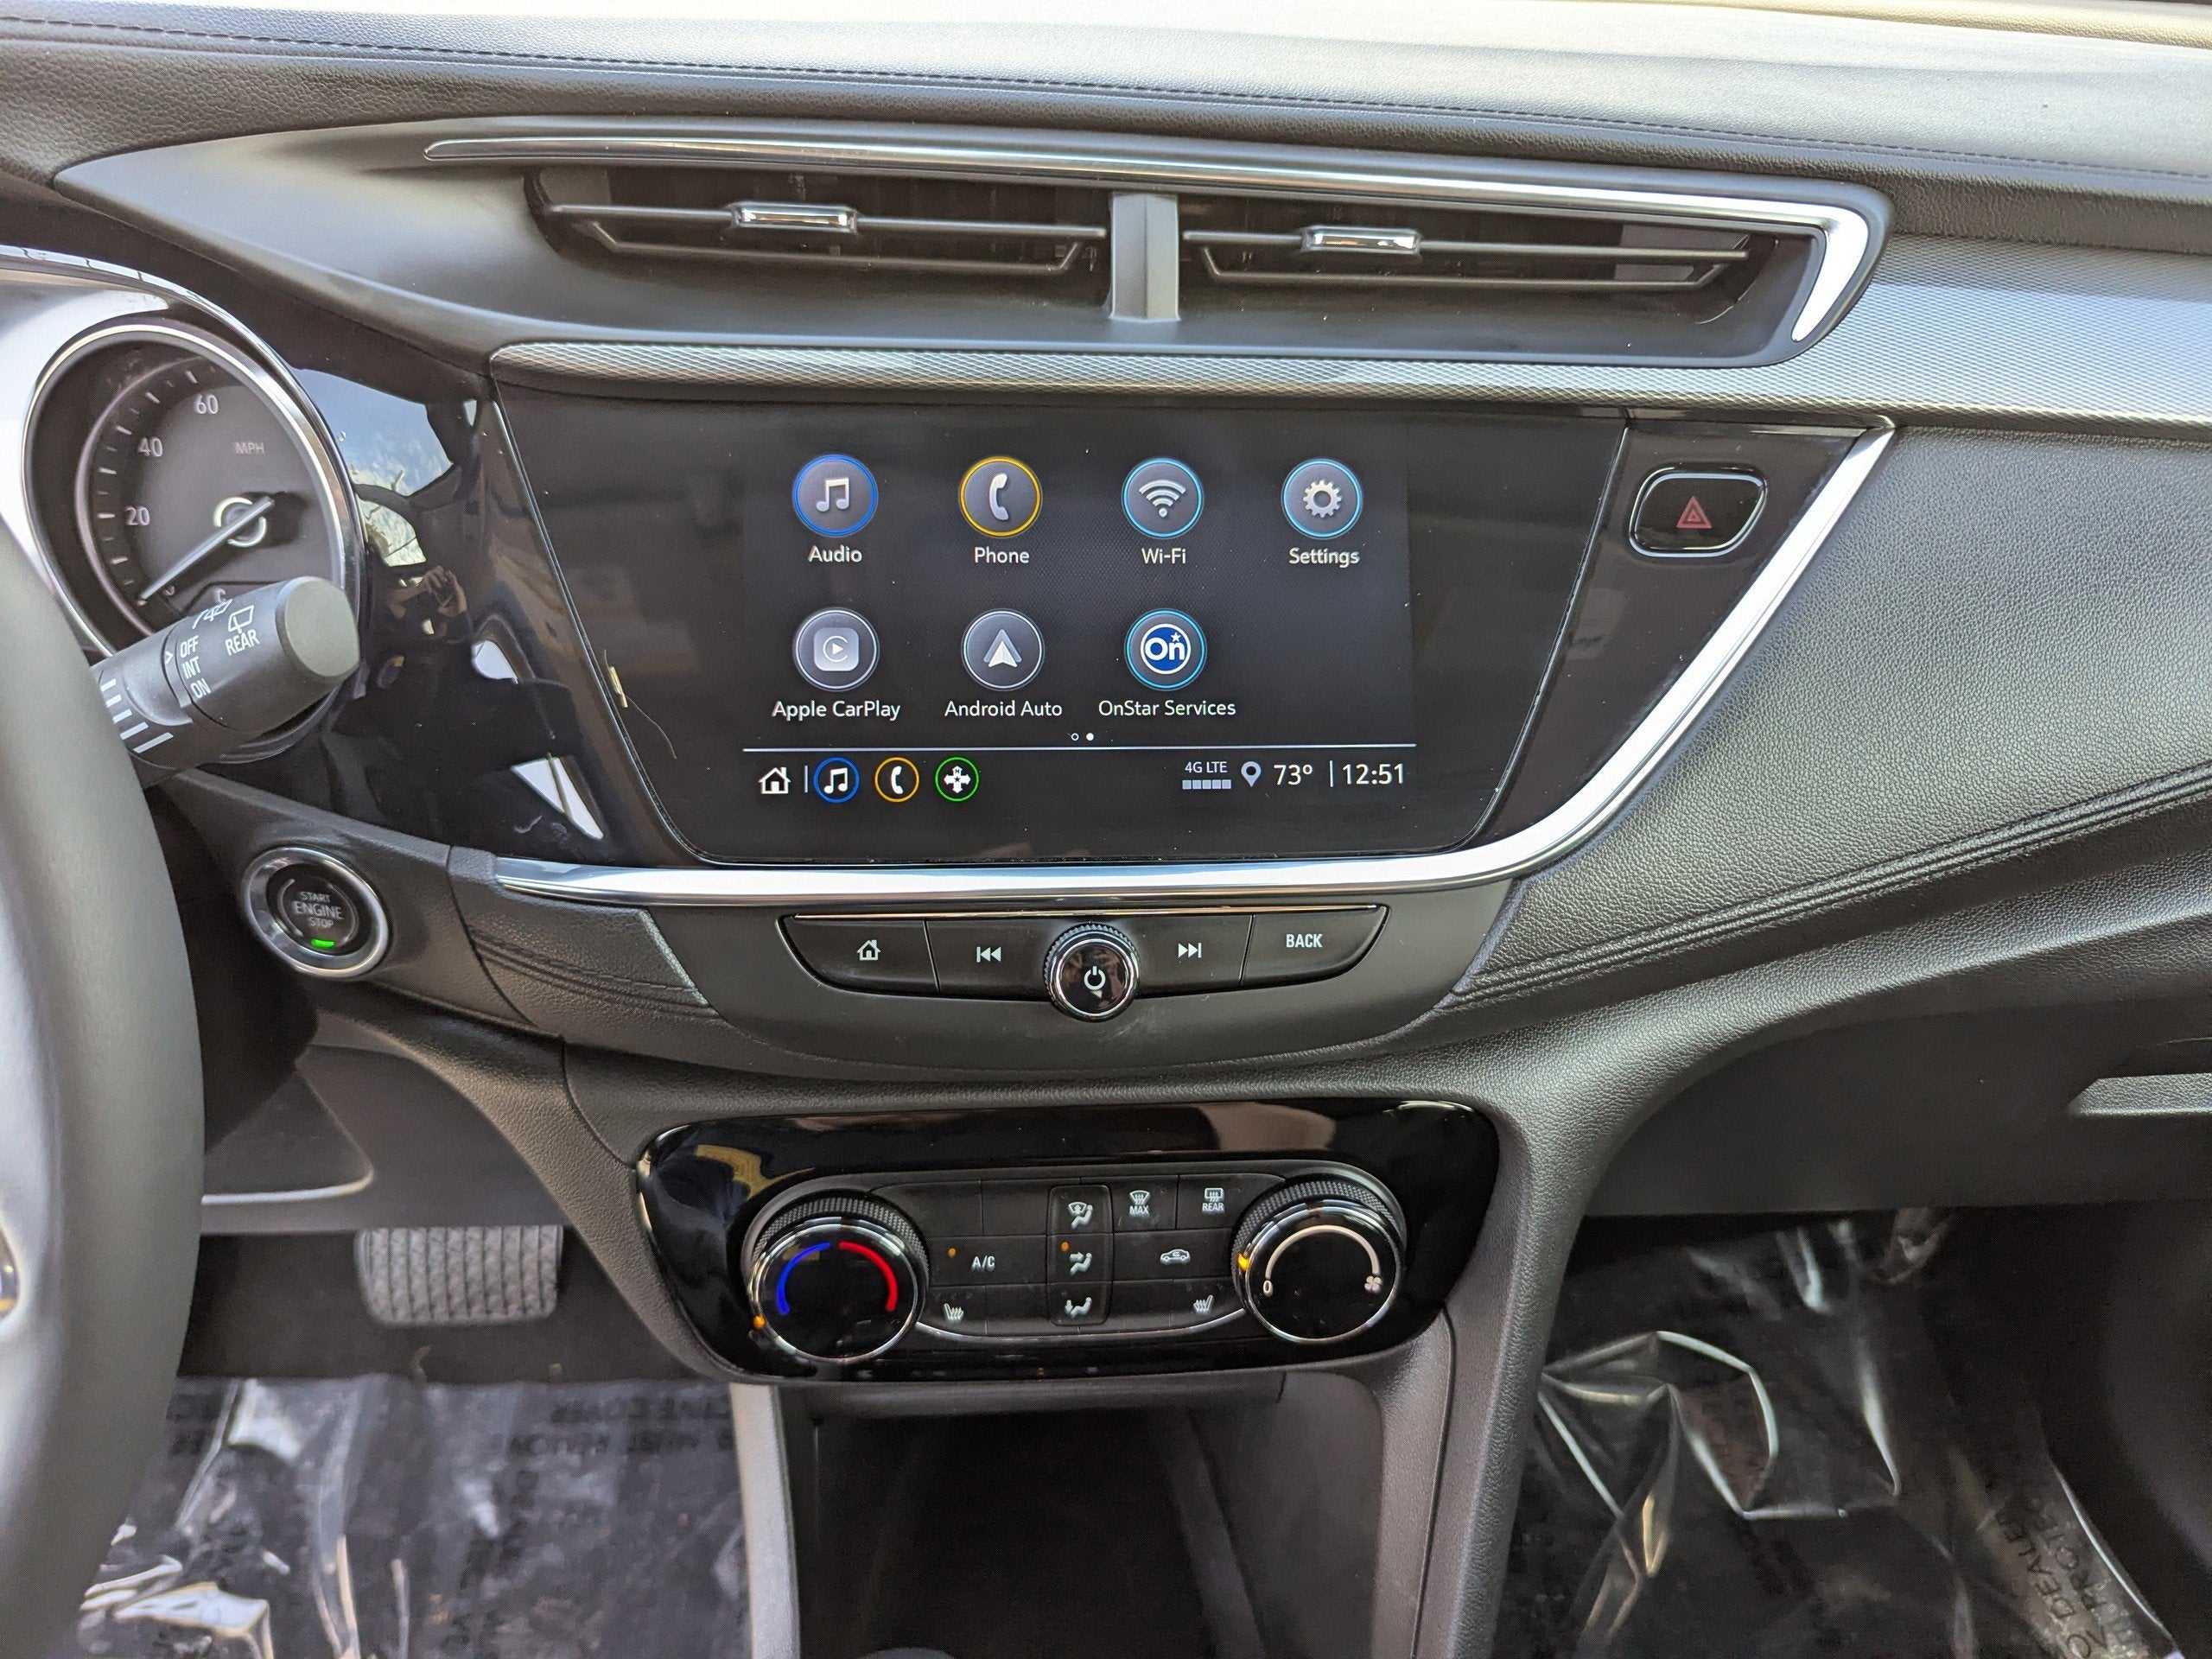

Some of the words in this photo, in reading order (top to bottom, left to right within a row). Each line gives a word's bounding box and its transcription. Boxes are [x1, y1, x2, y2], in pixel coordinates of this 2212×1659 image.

[195, 394, 219, 415] 60
[138, 436, 163, 457] 40
[234, 442, 264, 455] MPH
[126, 506, 150, 526] 20
[808, 545, 863, 566] Audio
[974, 547, 1030, 565] Phone
[1141, 547, 1186, 566] Wi-Fi
[1288, 547, 1360, 567] Settings
[180, 634, 200, 658] OFF
[225, 629, 260, 656] REAR
[181, 656, 201, 680] INT
[190, 677, 212, 698] ON
[772, 700, 828, 721] Apple
[831, 700, 901, 721] CarPlay
[944, 700, 1014, 719] Android
[1019, 700, 1063, 719] Auto
[1097, 700, 1160, 718] OnStar
[1165, 700, 1236, 717] Services
[1185, 761, 1203, 773] 4G
[1206, 761, 1227, 773] LTE
[1343, 763, 1405, 785] 12:51
[301, 891, 331, 903] START
[293, 901, 343, 919] ENGINE
[308, 917, 334, 928] STOP
[1286, 933, 1323, 949] BACK
[1129, 1205, 1149, 1216] MAX
[1202, 1202, 1224, 1213] REAR
[972, 1255, 995, 1270] A/C
